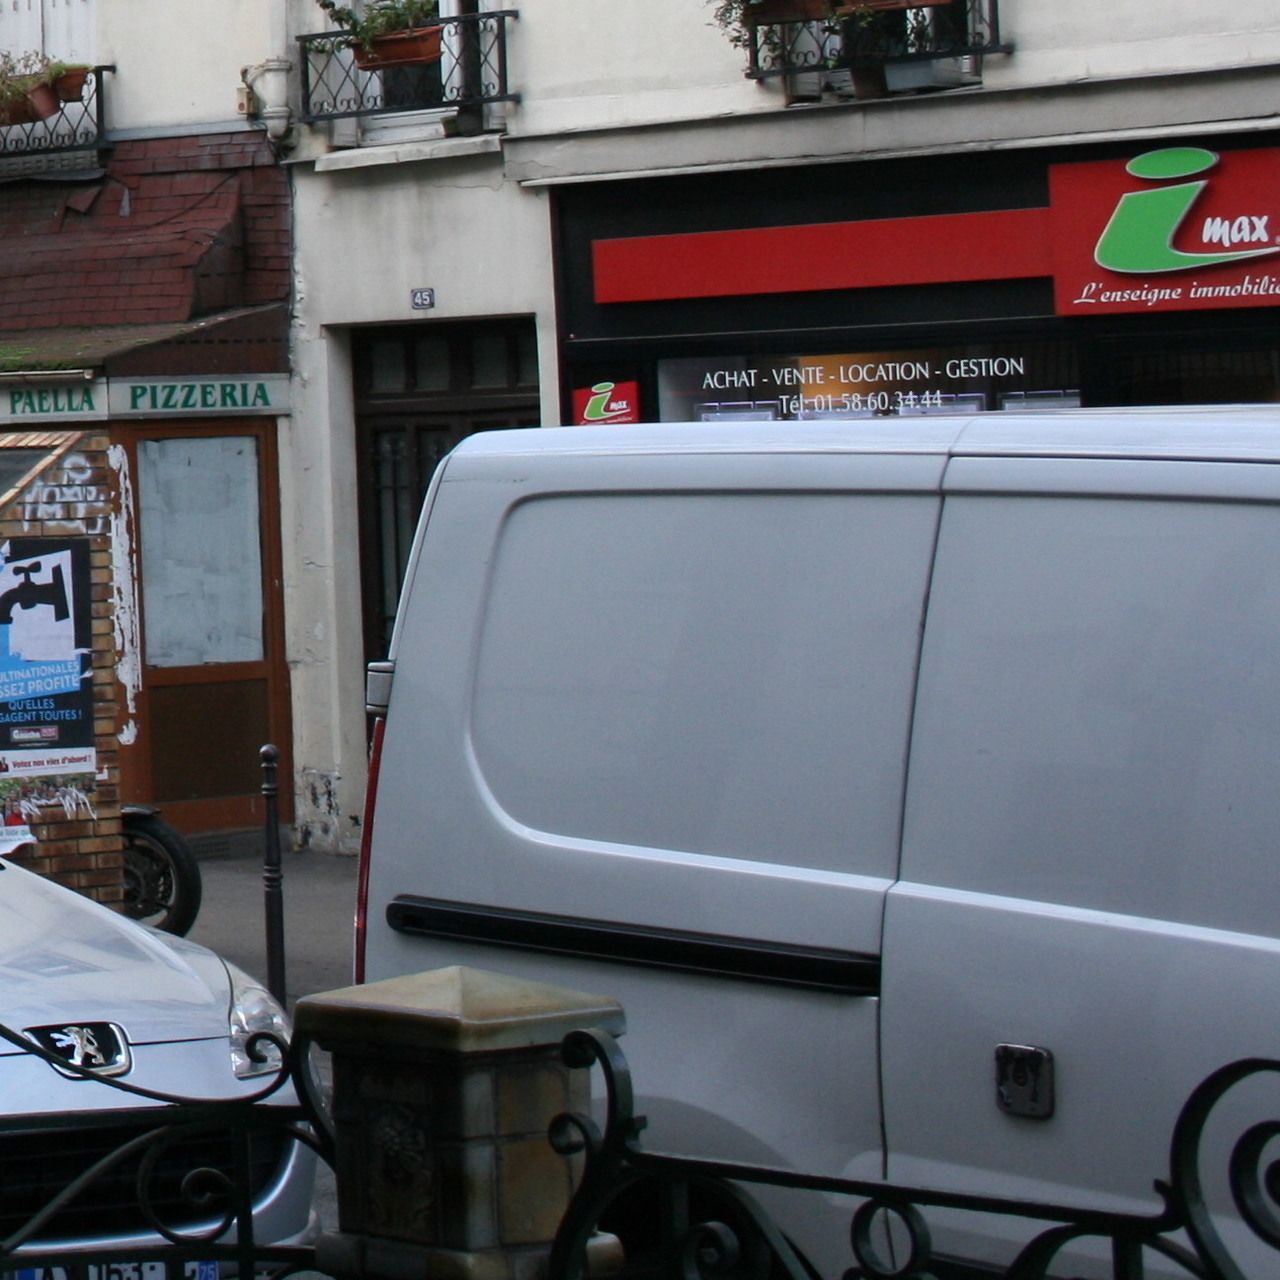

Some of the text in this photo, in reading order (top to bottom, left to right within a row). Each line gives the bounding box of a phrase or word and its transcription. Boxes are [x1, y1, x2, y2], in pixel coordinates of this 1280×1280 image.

[414, 292, 430, 305] 45
[1073, 282, 1182, 306] L'enseigne
[703, 369, 757, 389] ACHAT
[772, 366, 824, 385] VENTE
[840, 362, 929, 382] LOCATION
[945, 358, 1024, 378] GESTION
[9, 388, 95, 415] PAELLA
[130, 383, 272, 411] PIZZERIA
[814, 390, 942, 413] 01.58.60.34.44
[8, 699, 55, 710] QU'ELLES
[40, 710, 77, 721] TOUTES
